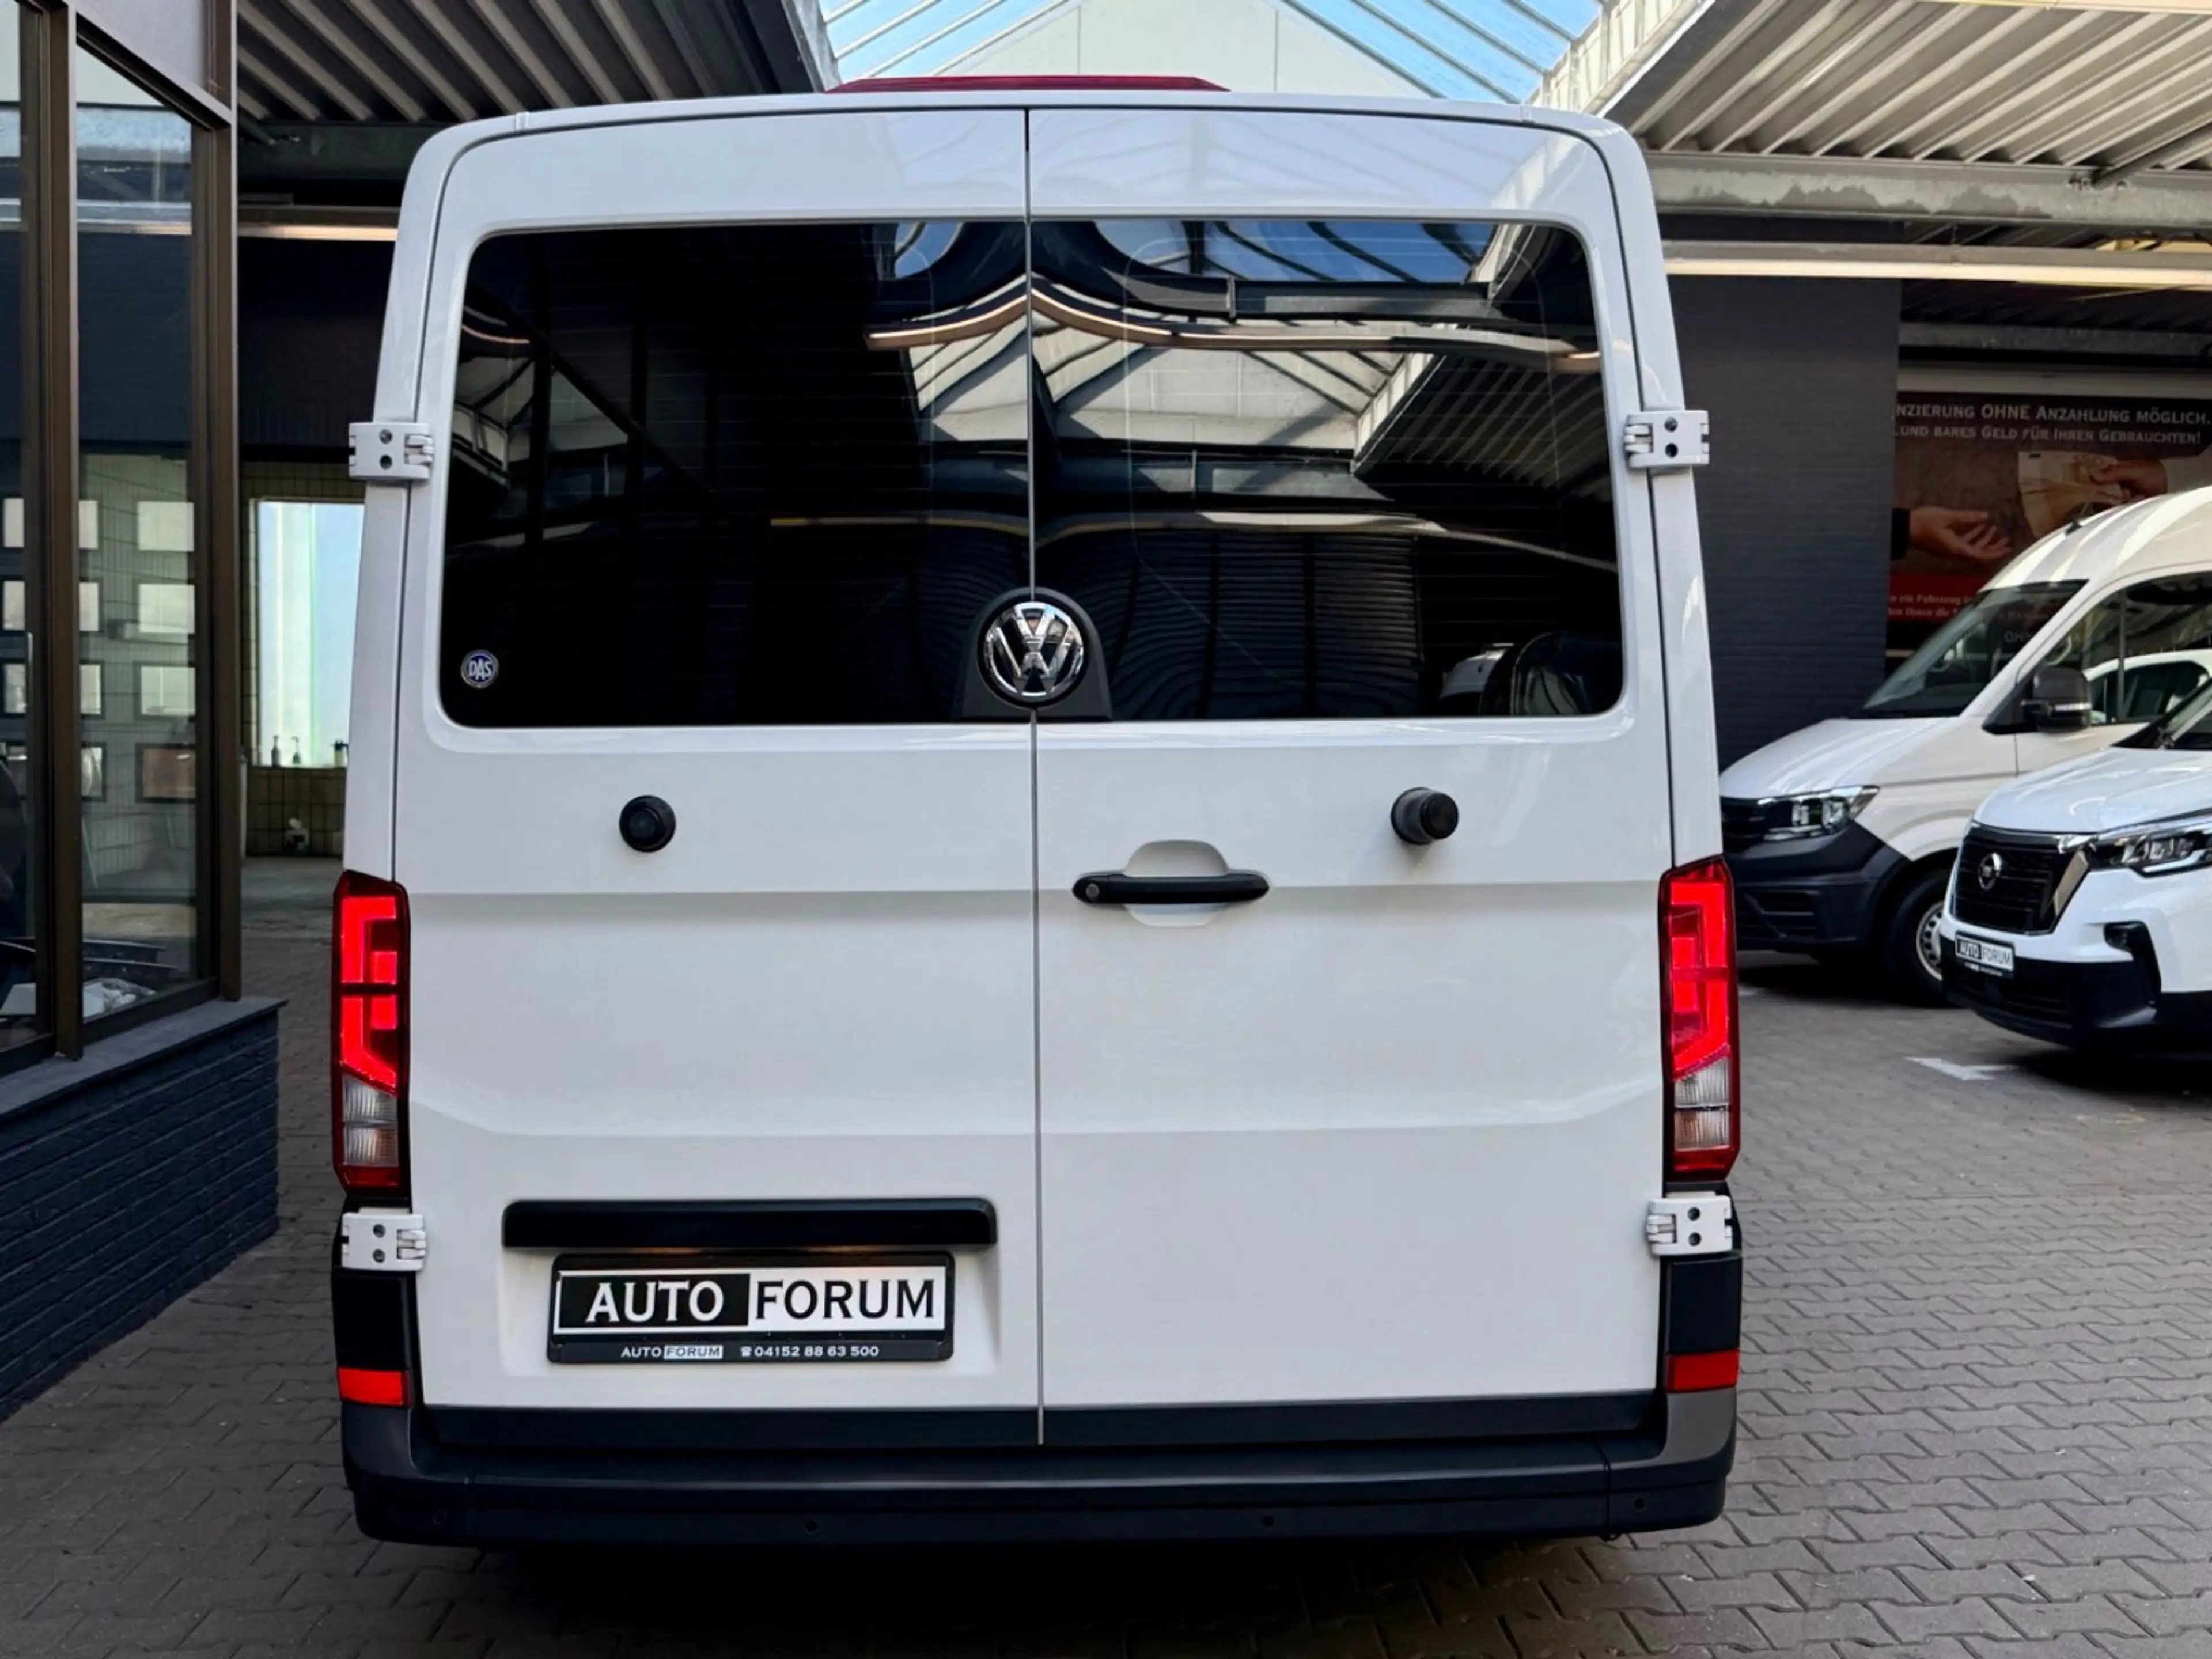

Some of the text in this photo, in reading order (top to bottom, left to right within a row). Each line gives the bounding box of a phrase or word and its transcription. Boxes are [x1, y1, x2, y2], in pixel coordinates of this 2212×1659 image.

[1893, 403, 2211, 425] NZIERUNG OHNE ANZAHLUNG MÖGLICH.
[1934, 426, 1976, 438] BARES
[1981, 425, 2018, 439] GELD
[2022, 426, 2048, 440] FÜR
[2054, 428, 2094, 441] IHREN
[2099, 429, 2201, 444] GEBRAUCHTEN!
[468, 658, 492, 681] DAS
[586, 1279, 934, 1323] AUTO FORUM
[621, 1345, 880, 1358] AUTO FORUM 04152 88 63 500
